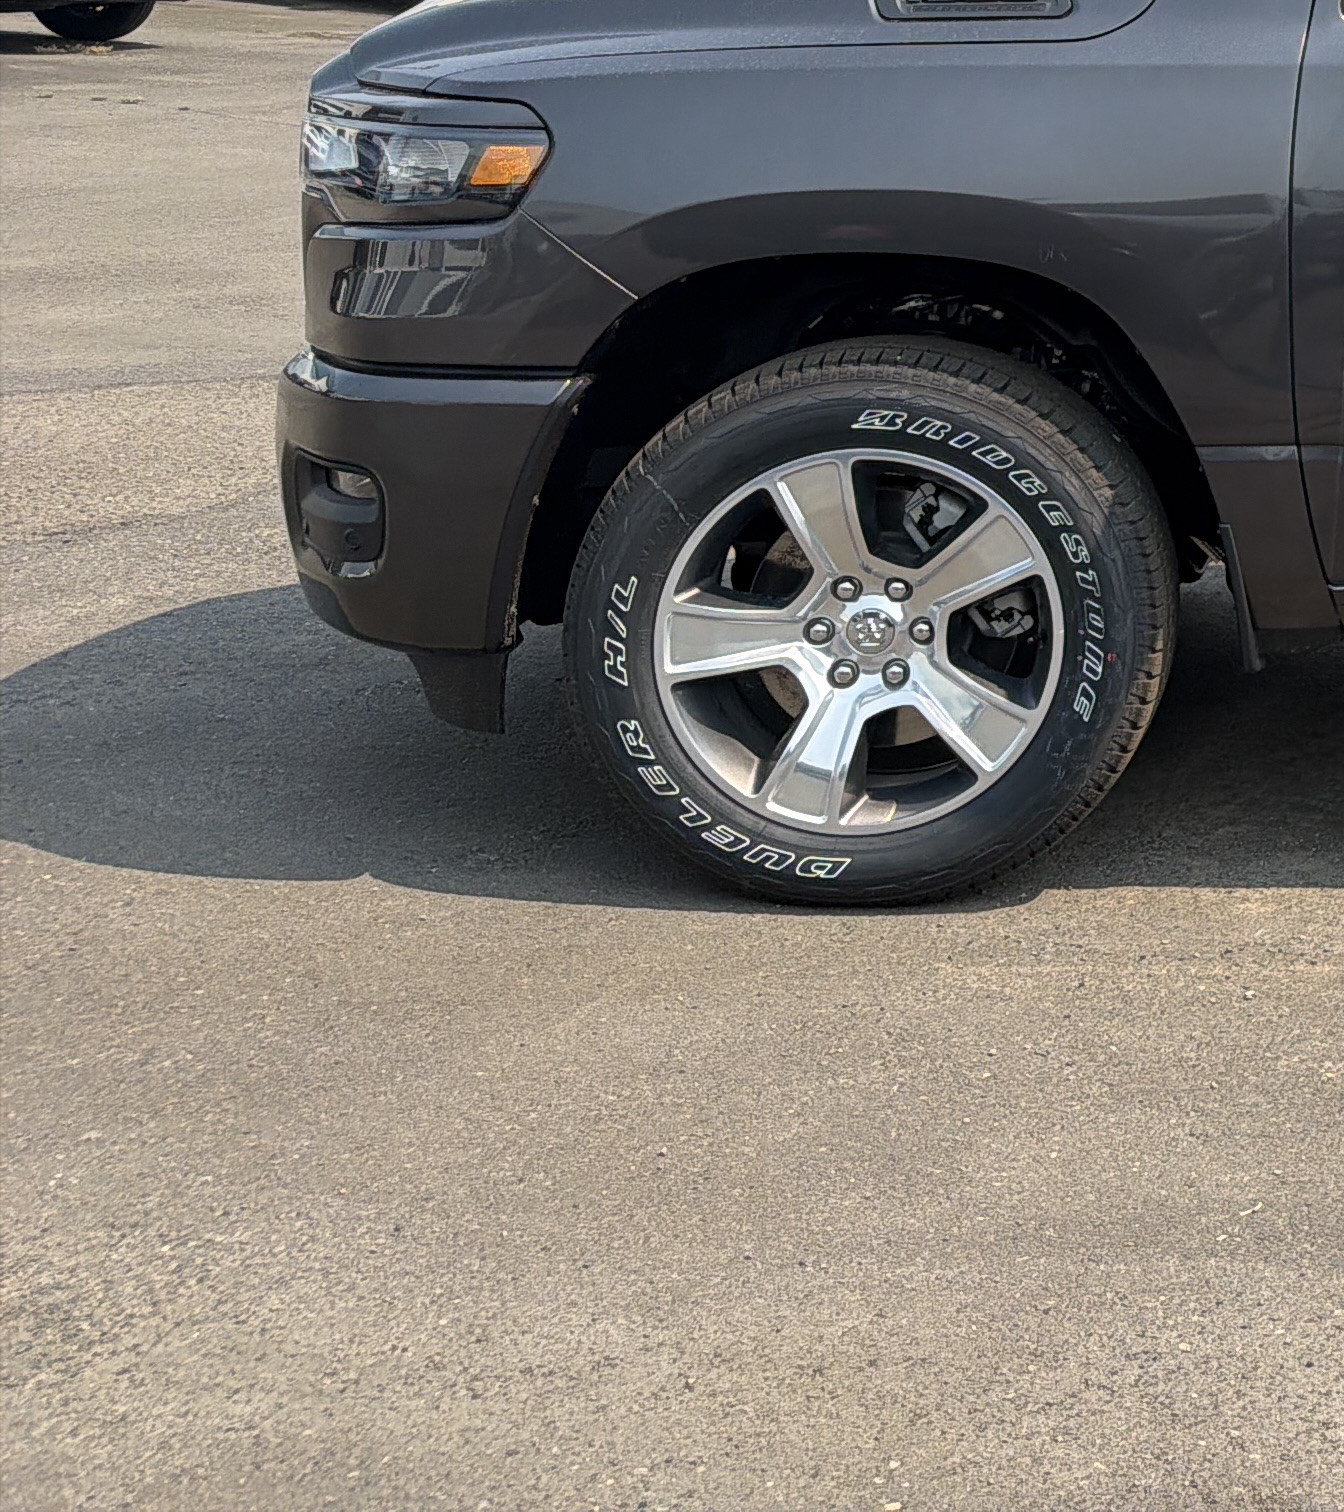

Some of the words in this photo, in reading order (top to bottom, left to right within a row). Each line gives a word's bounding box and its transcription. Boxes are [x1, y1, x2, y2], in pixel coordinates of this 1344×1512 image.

[604, 574, 637, 687] H/L
[850, 408, 1105, 724] BRIDGESTONE
[616, 718, 853, 879] DUELER
